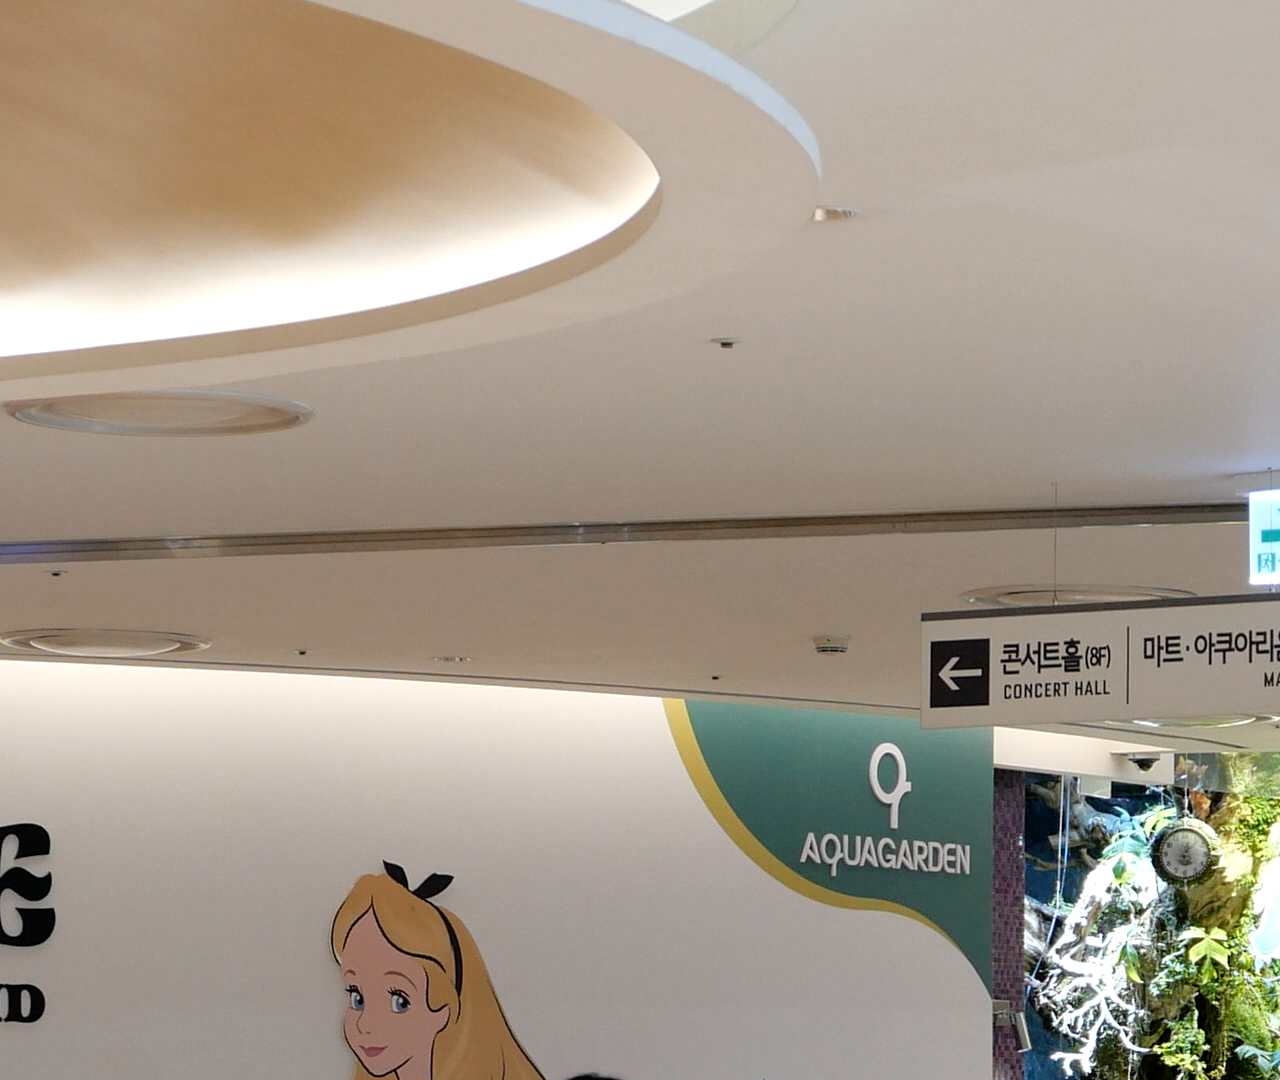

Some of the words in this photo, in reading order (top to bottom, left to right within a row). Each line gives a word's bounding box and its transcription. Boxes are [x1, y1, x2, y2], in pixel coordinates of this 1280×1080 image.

[1003, 681, 1070, 700] CONCERT
[1074, 679, 1111, 697] HALL
[800, 832, 970, 877] AQUAGARDEN
